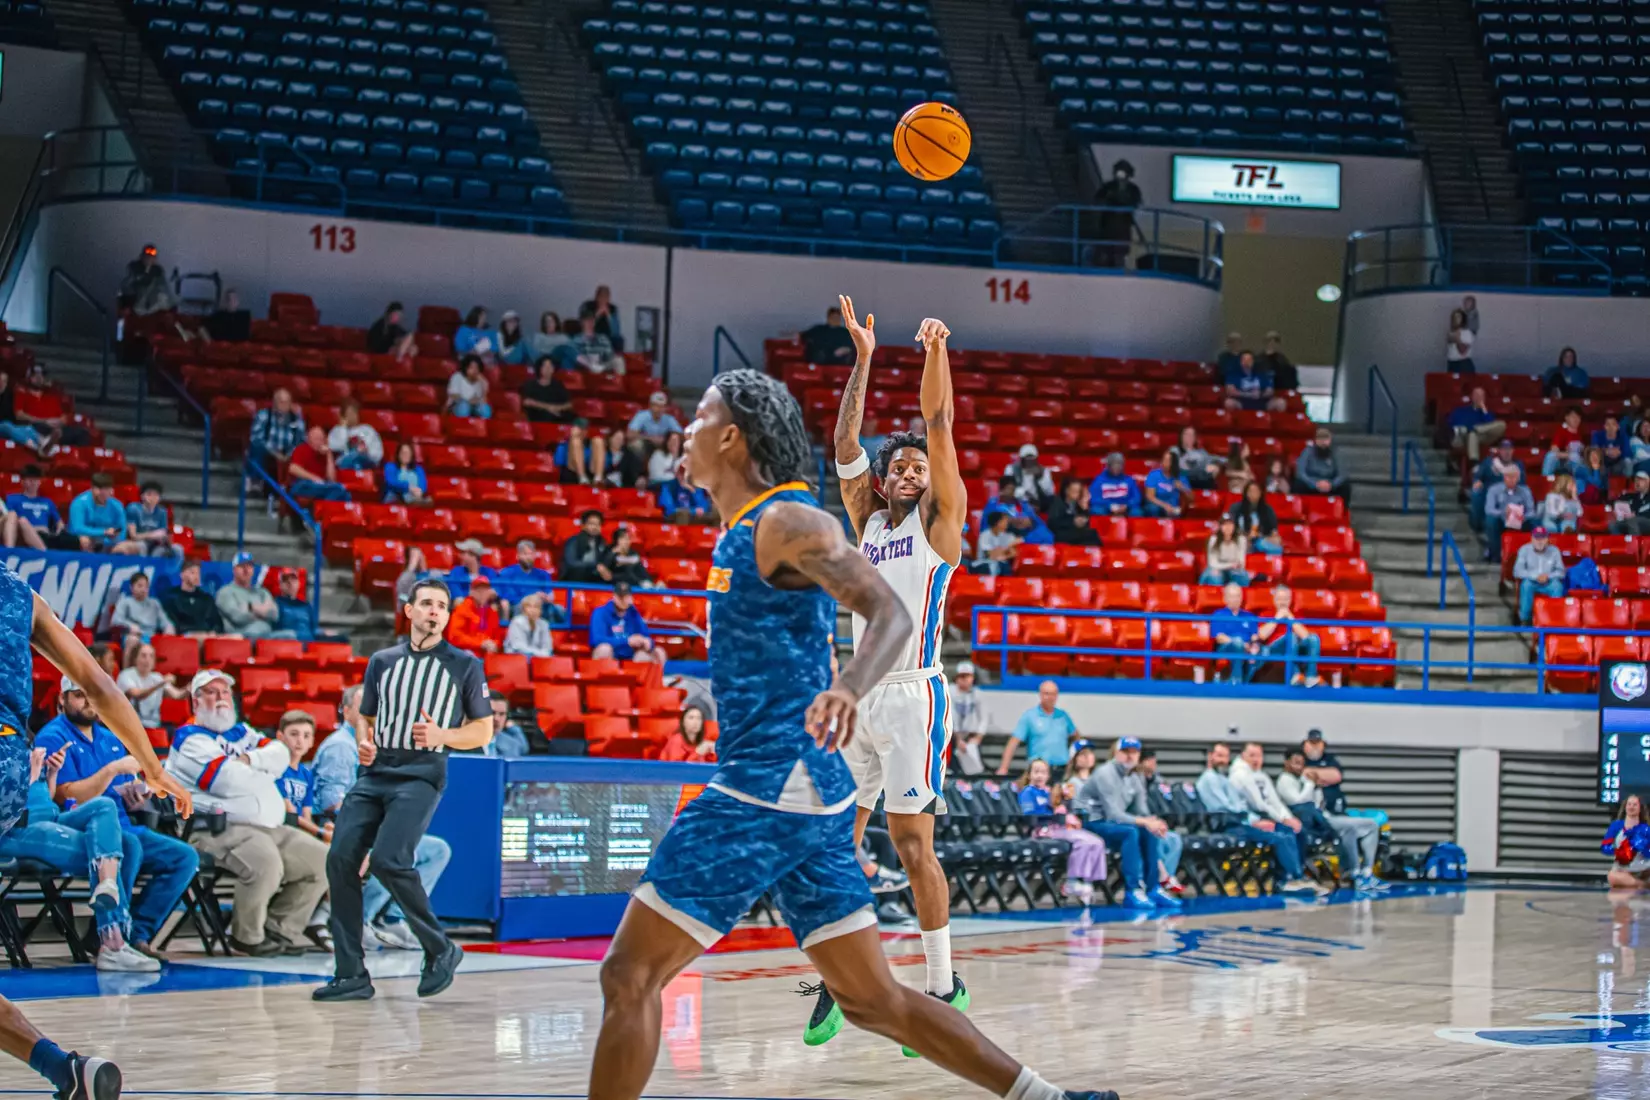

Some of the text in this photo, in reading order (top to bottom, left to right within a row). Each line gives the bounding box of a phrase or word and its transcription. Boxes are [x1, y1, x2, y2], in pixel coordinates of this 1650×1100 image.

[1232, 163, 1284, 189] TFL
[309, 222, 356, 253] 113
[985, 276, 1032, 305] 114
[888, 535, 914, 560] TECH
[1602, 761, 1619, 775] 11
[1602, 775, 1620, 789] 13
